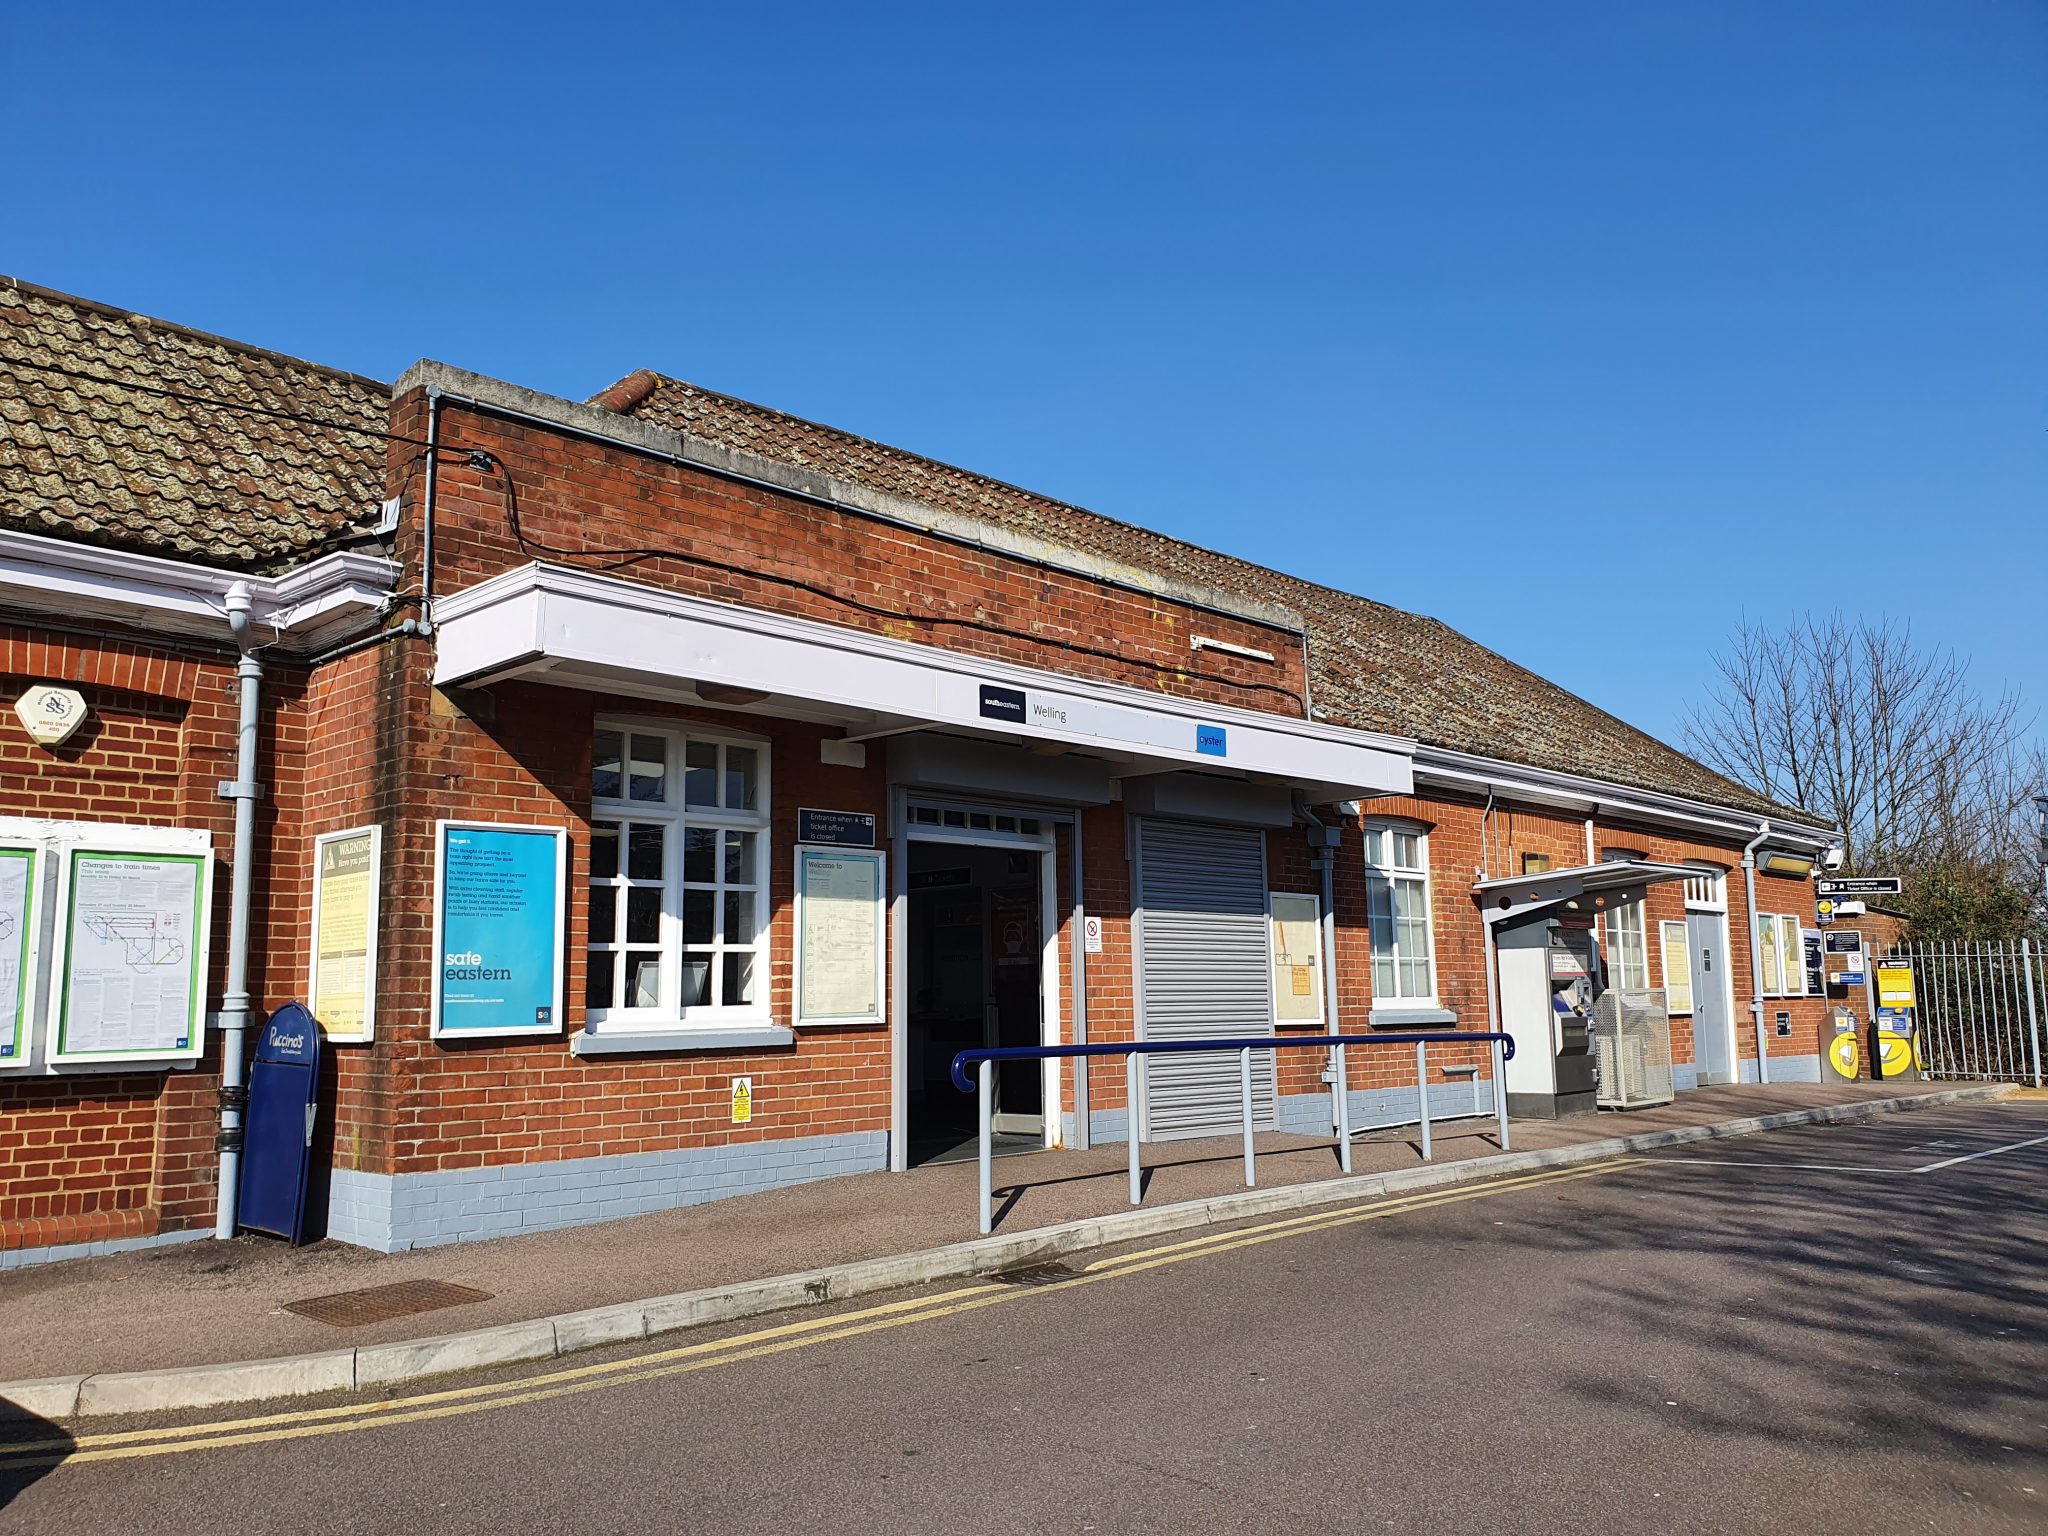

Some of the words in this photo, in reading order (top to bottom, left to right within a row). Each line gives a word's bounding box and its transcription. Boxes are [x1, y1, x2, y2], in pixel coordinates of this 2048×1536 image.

[1034, 704, 1066, 723] Welling
[811, 813, 836, 821] Entrance
[339, 839, 371, 855] WARNING
[82, 862, 113, 871] Changes
[446, 951, 482, 965] safe
[446, 966, 511, 980] eastern
[269, 1026, 304, 1048] Puccino's
